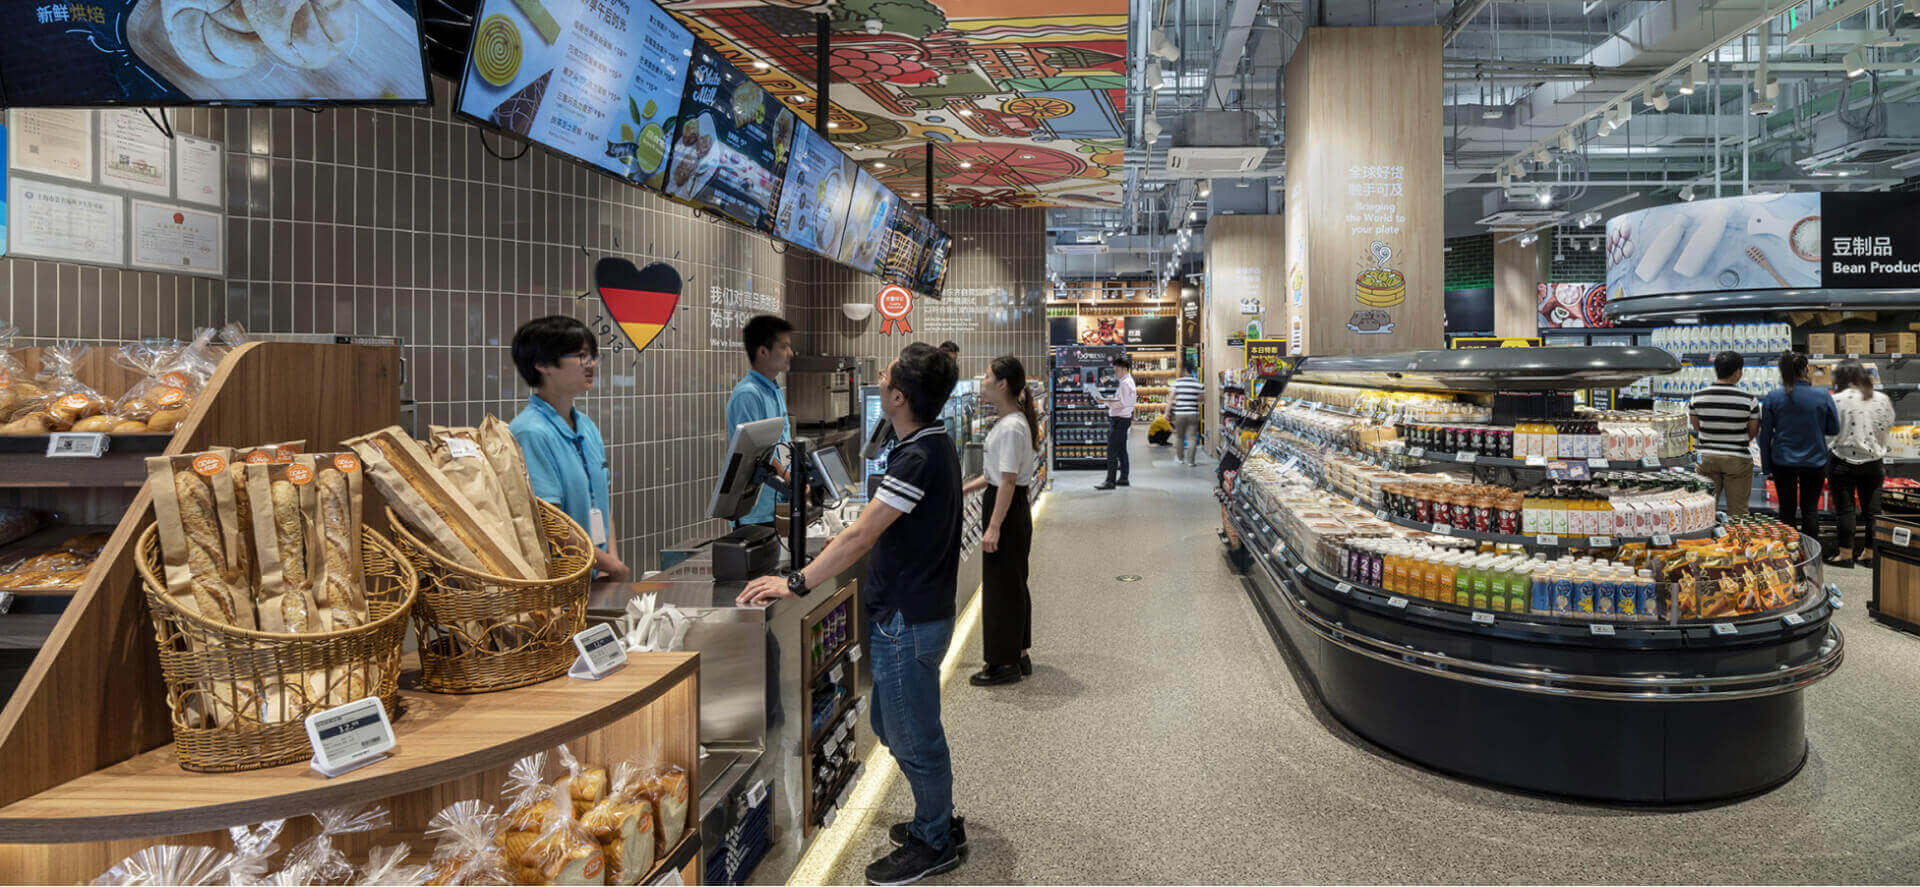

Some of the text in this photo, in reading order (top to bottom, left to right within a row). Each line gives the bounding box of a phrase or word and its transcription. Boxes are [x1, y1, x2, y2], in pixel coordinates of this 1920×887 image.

[36, 3, 105, 24] 新鲜烘焙
[1347, 165, 1405, 180] 全球好货
[1355, 201, 1396, 214] Bringing
[1345, 213, 1406, 223] the World to
[1351, 224, 1400, 236] your plate
[1832, 235, 1893, 257] 豆制品
[1832, 261, 1866, 274] Bean
[591, 315, 624, 353] 1913
